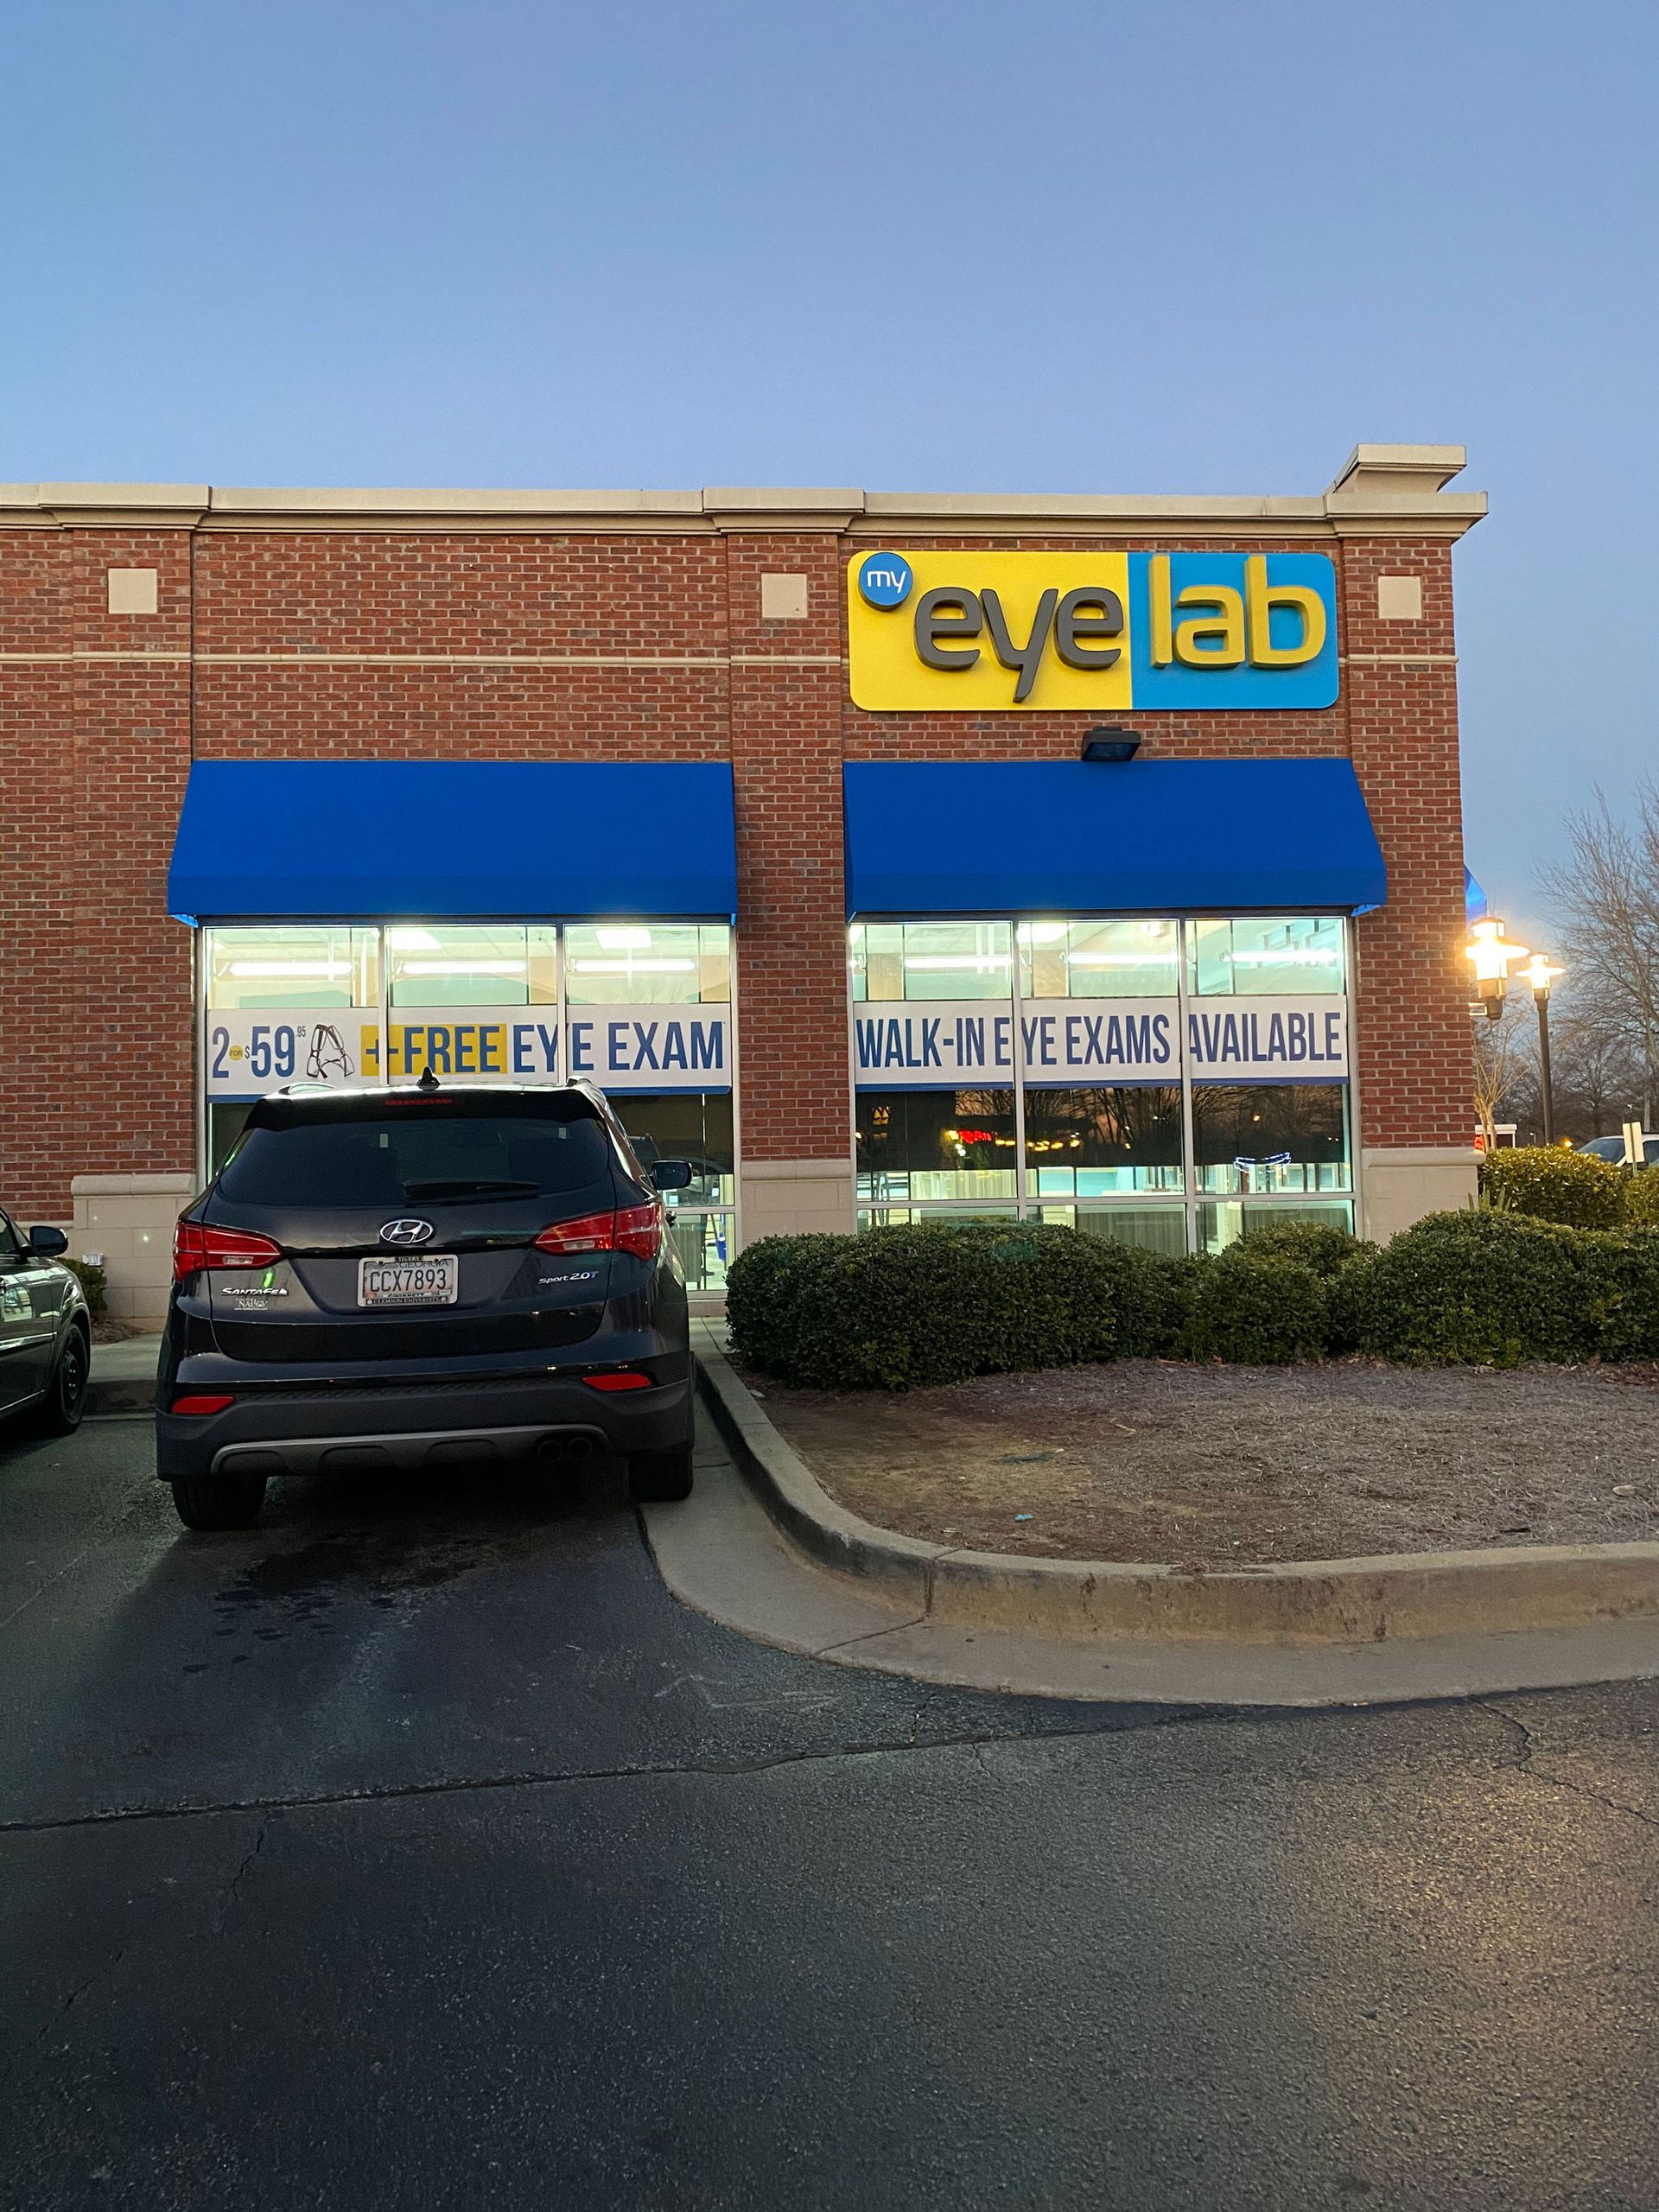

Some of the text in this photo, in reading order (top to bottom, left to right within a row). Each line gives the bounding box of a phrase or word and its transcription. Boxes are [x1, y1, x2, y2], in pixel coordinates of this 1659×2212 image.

[867, 555, 1326, 702] my eye lab
[212, 1026, 230, 1078] 2
[513, 1023, 594, 1072] EYE
[608, 1021, 723, 1071] EXAM
[856, 1012, 1342, 1068] WALK-IN EYE EXAMS AVAILABLE
[370, 1269, 447, 1293] CCX7893
